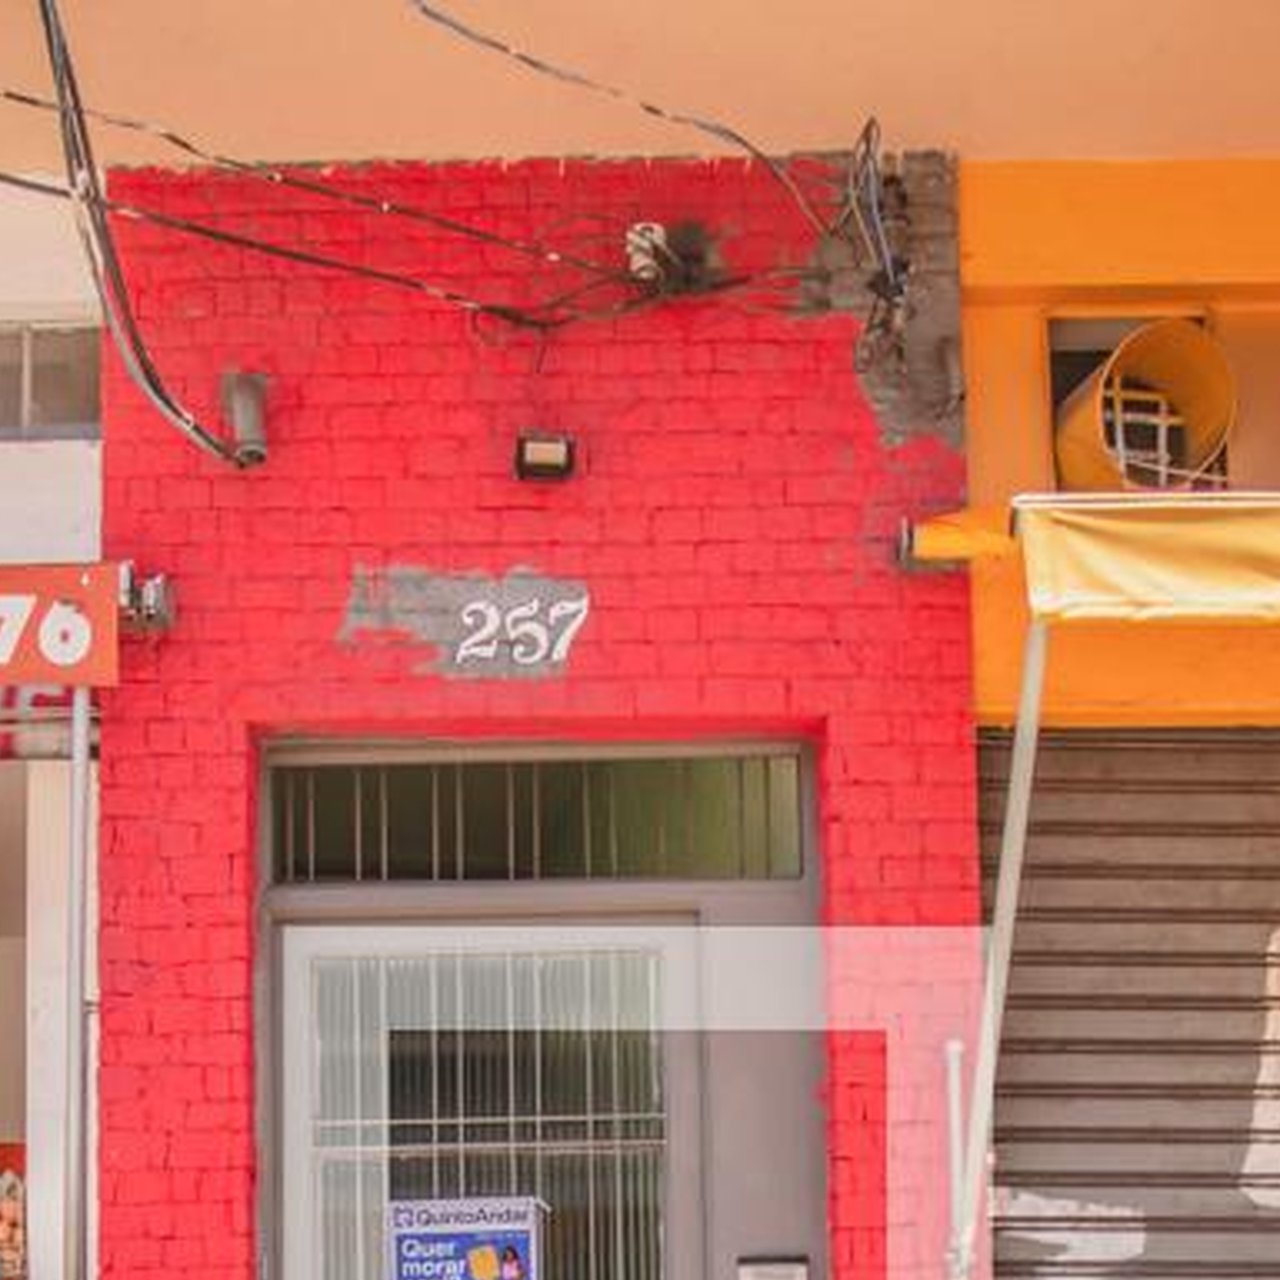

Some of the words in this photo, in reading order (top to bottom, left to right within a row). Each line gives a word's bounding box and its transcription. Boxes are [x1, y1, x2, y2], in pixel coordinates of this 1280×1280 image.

[454, 598, 590, 664] 257
[401, 1239, 456, 1258] Quer
[402, 1259, 466, 1276] morar
